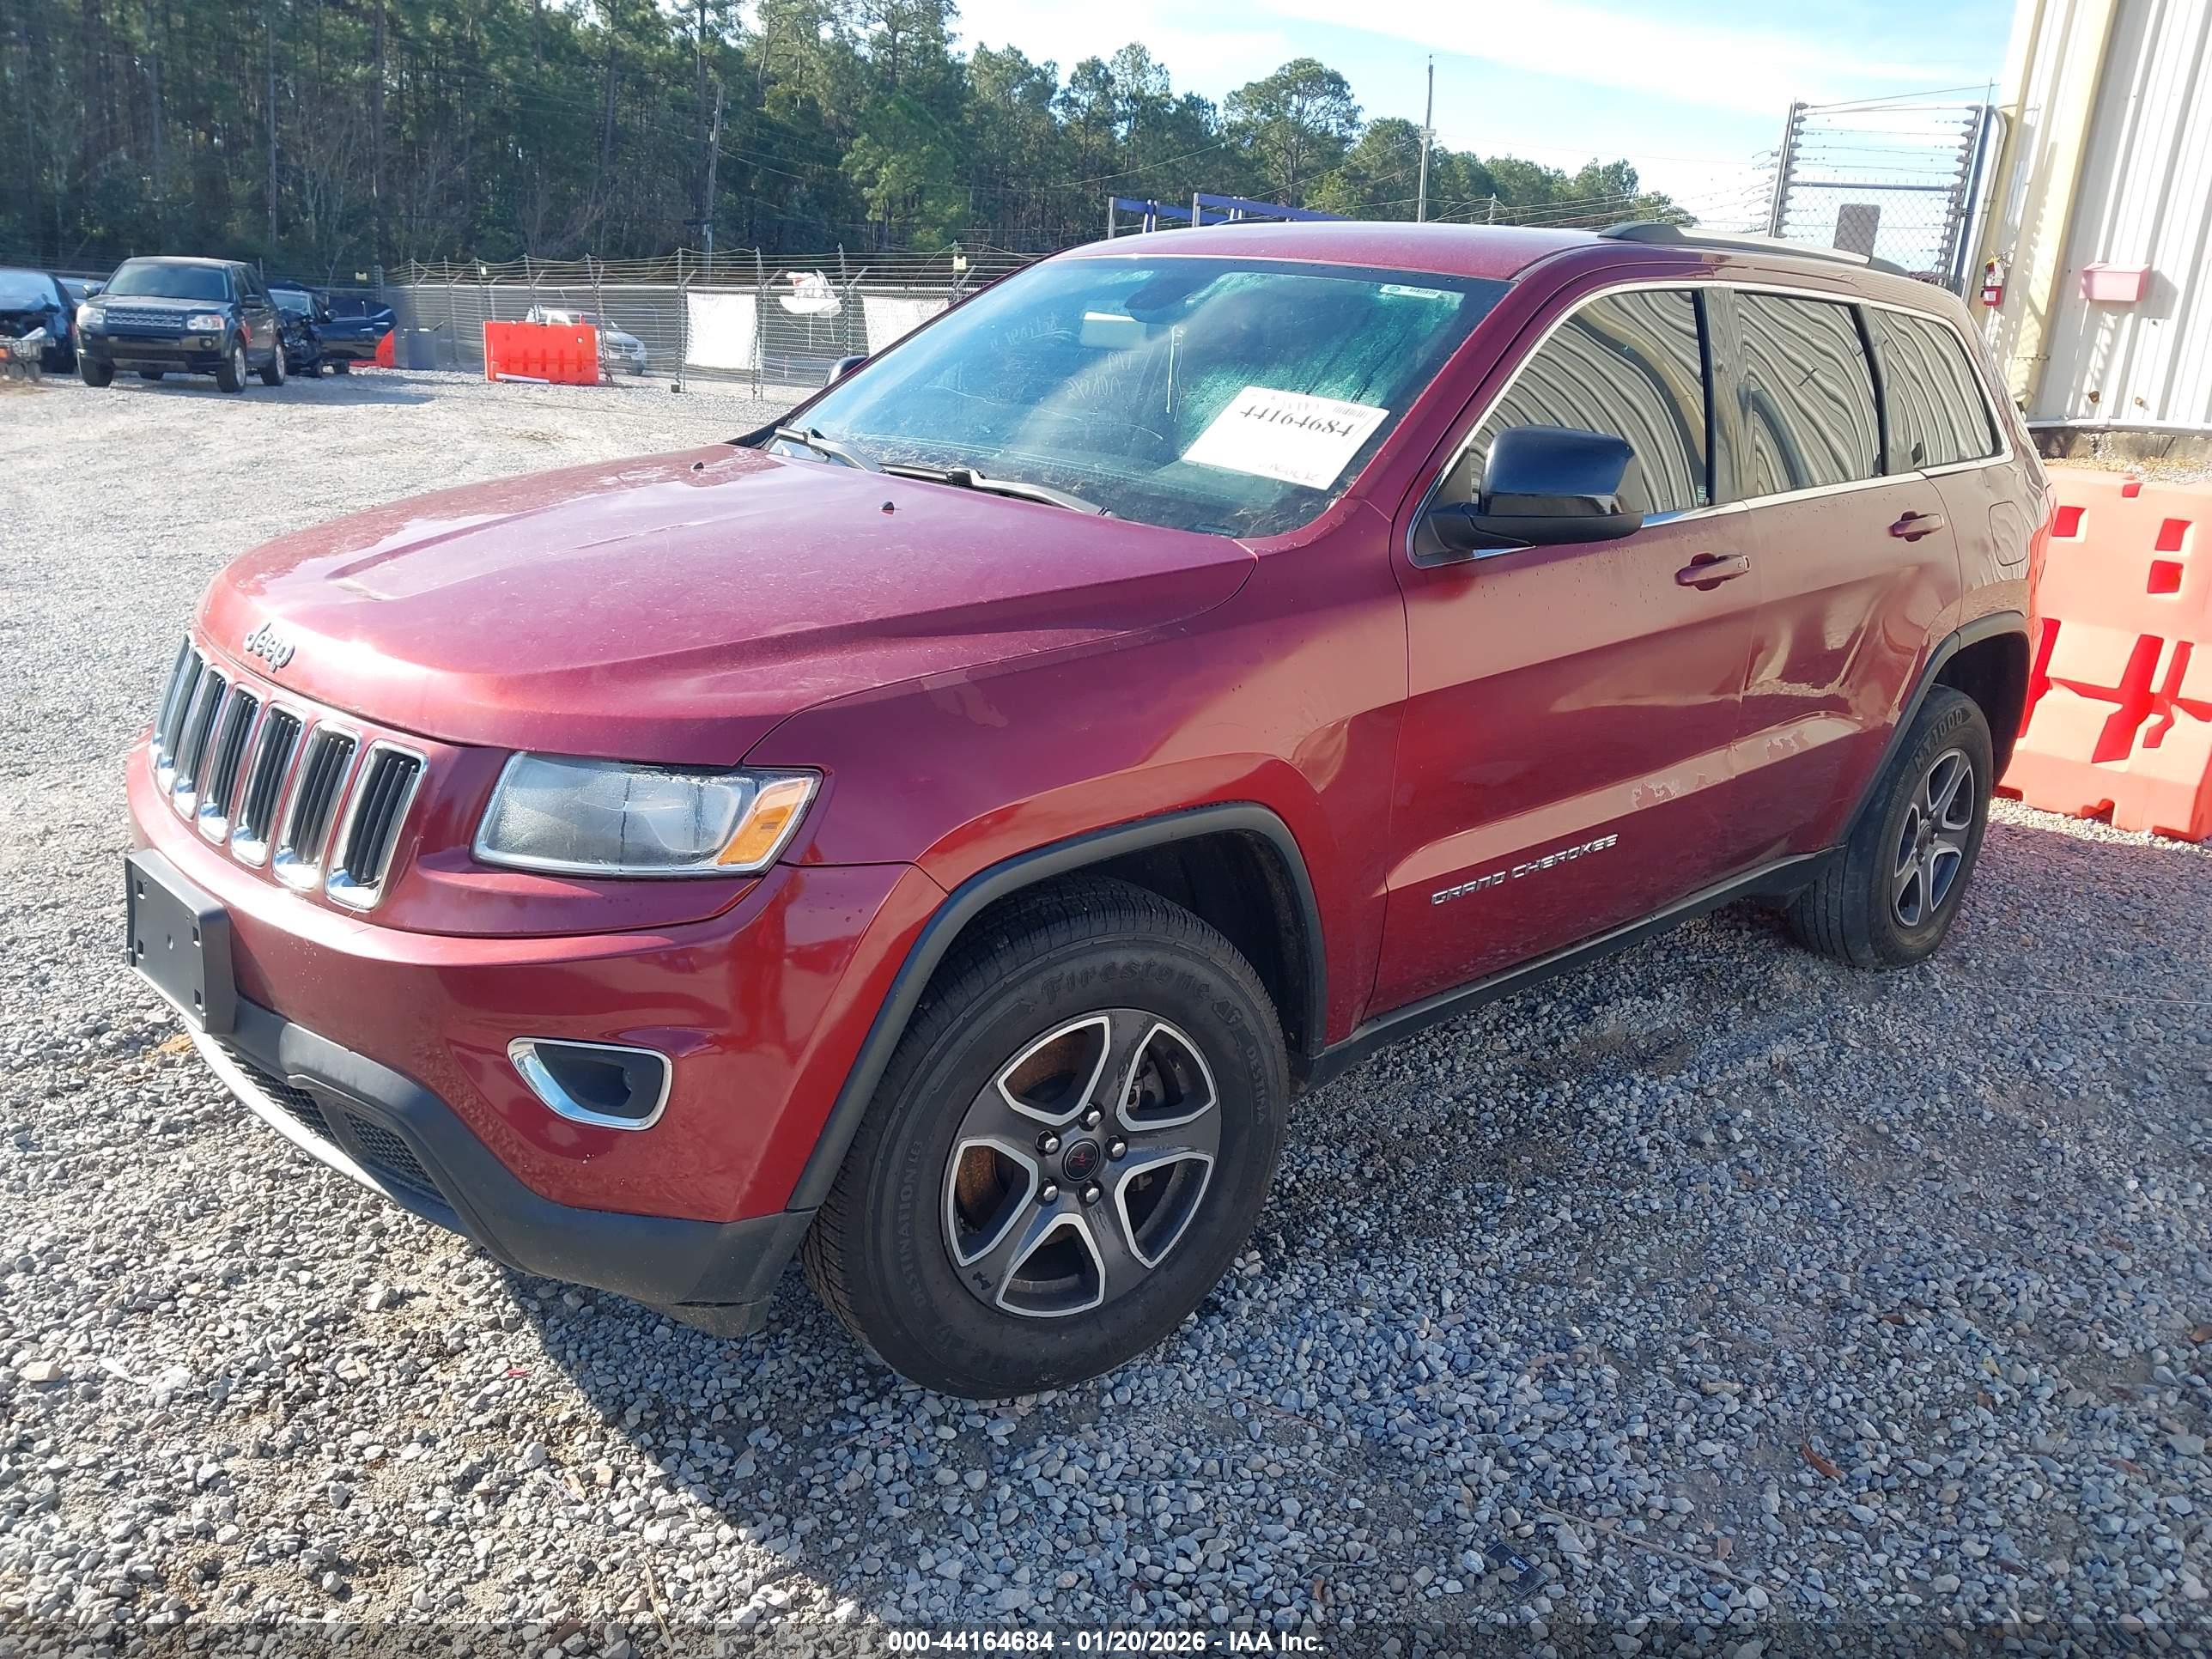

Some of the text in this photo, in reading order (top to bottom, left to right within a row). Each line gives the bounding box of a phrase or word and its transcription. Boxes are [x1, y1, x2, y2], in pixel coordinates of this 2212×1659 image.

[1240, 405, 1354, 437] 44164684
[246, 623, 295, 673] Jeep
[1431, 834, 1619, 906] GRAND CHEROKEE
[1041, 958, 1210, 1004] Firestone
[898, 1168, 927, 1309] DESTINATION
